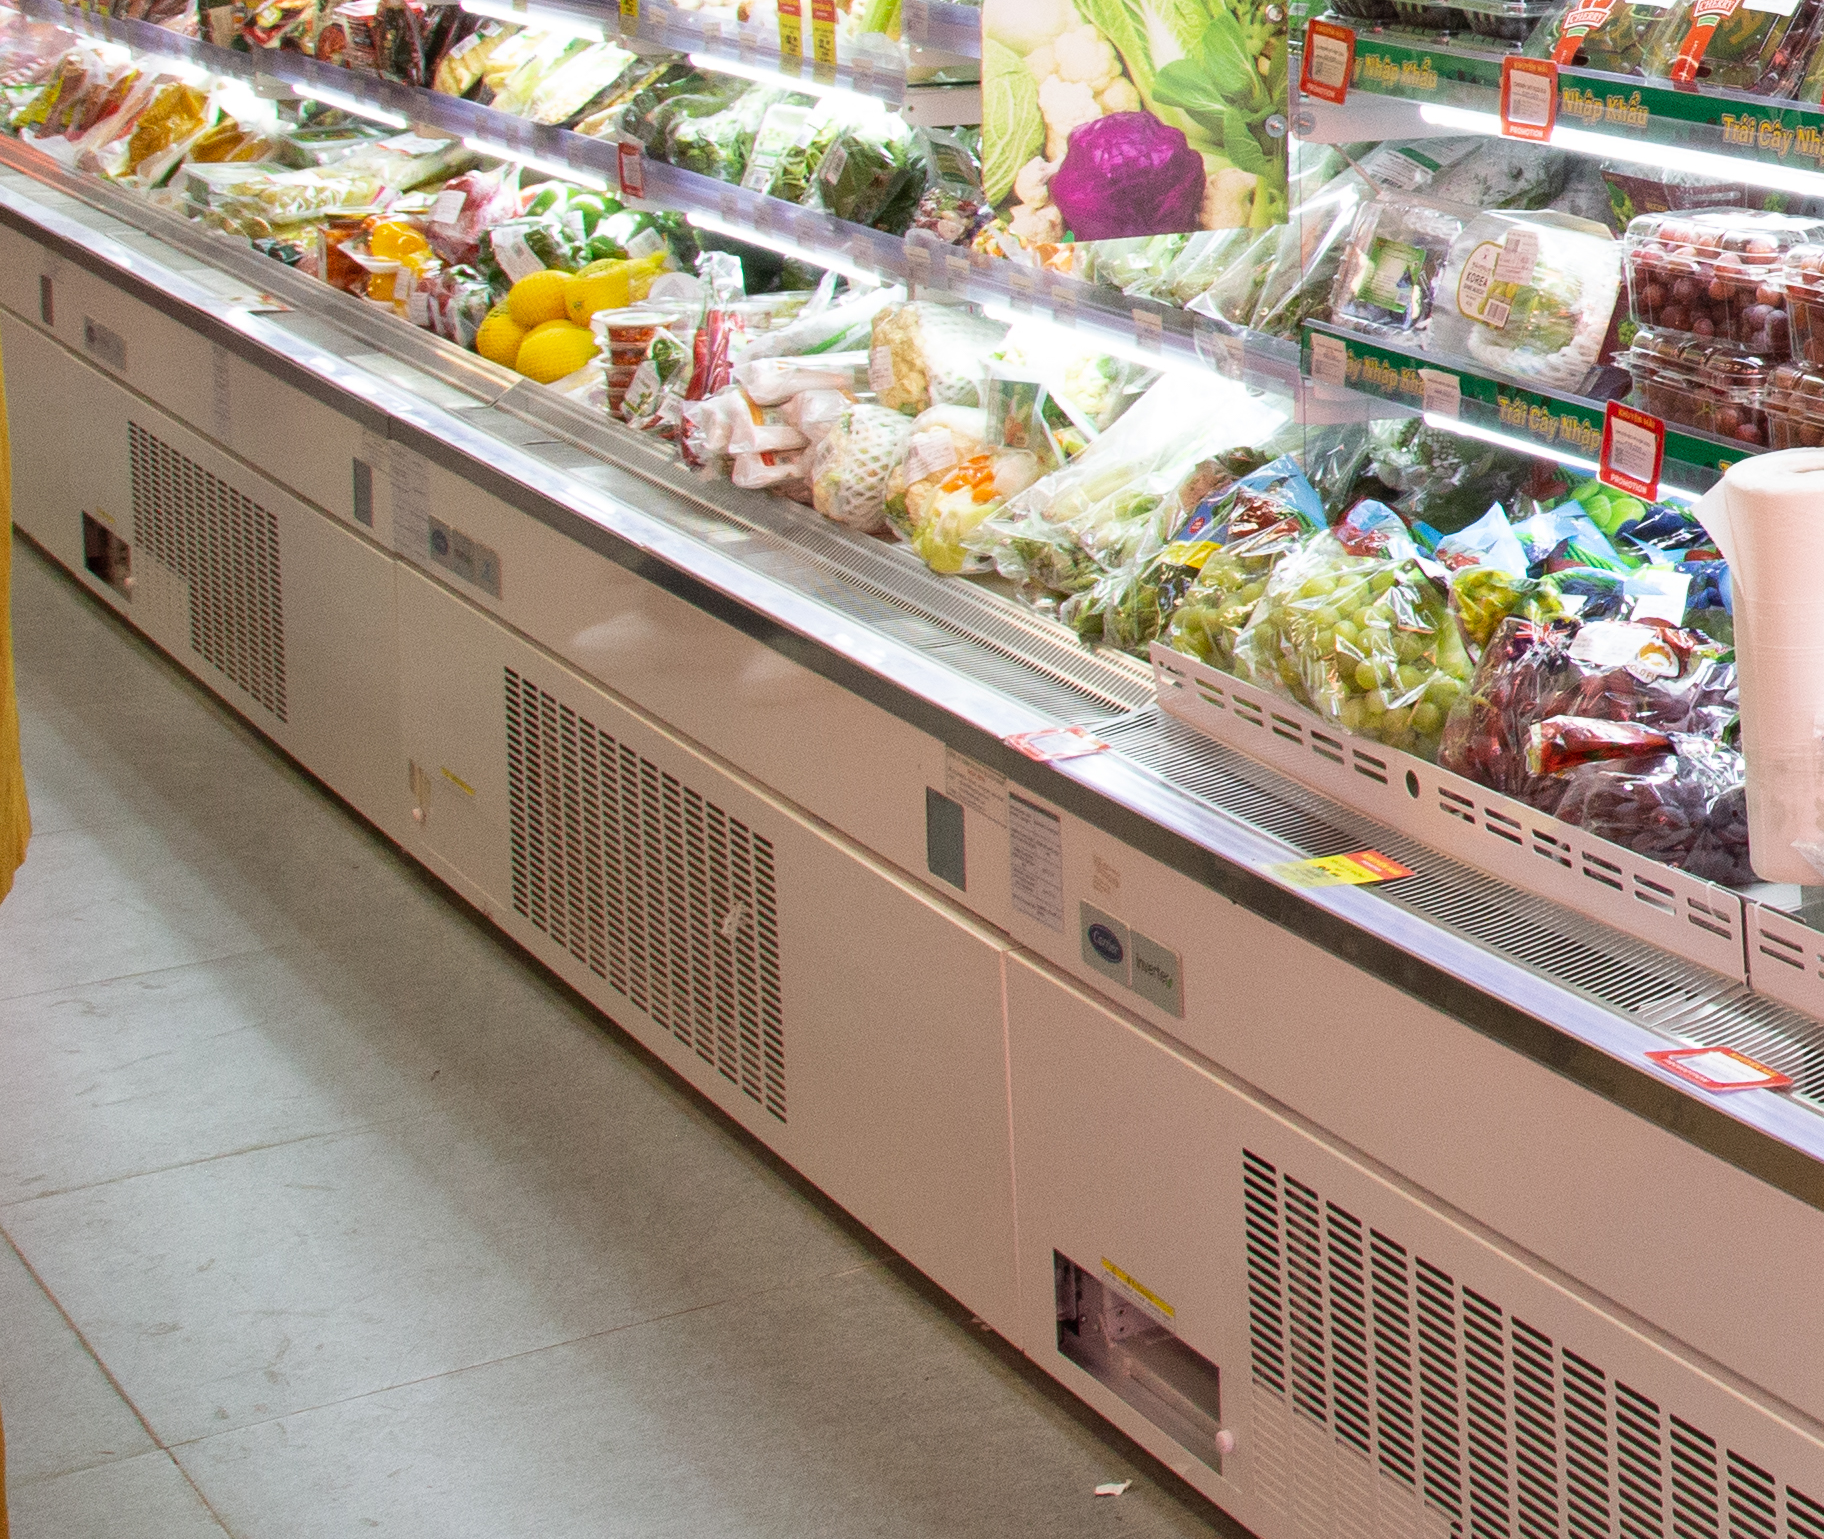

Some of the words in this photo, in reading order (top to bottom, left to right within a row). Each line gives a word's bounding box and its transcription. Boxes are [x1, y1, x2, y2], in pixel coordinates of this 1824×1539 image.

[1566, 4, 1611, 29] CHERRY
[1720, 113, 1756, 145] Trái
[1756, 122, 1794, 155] Cây
